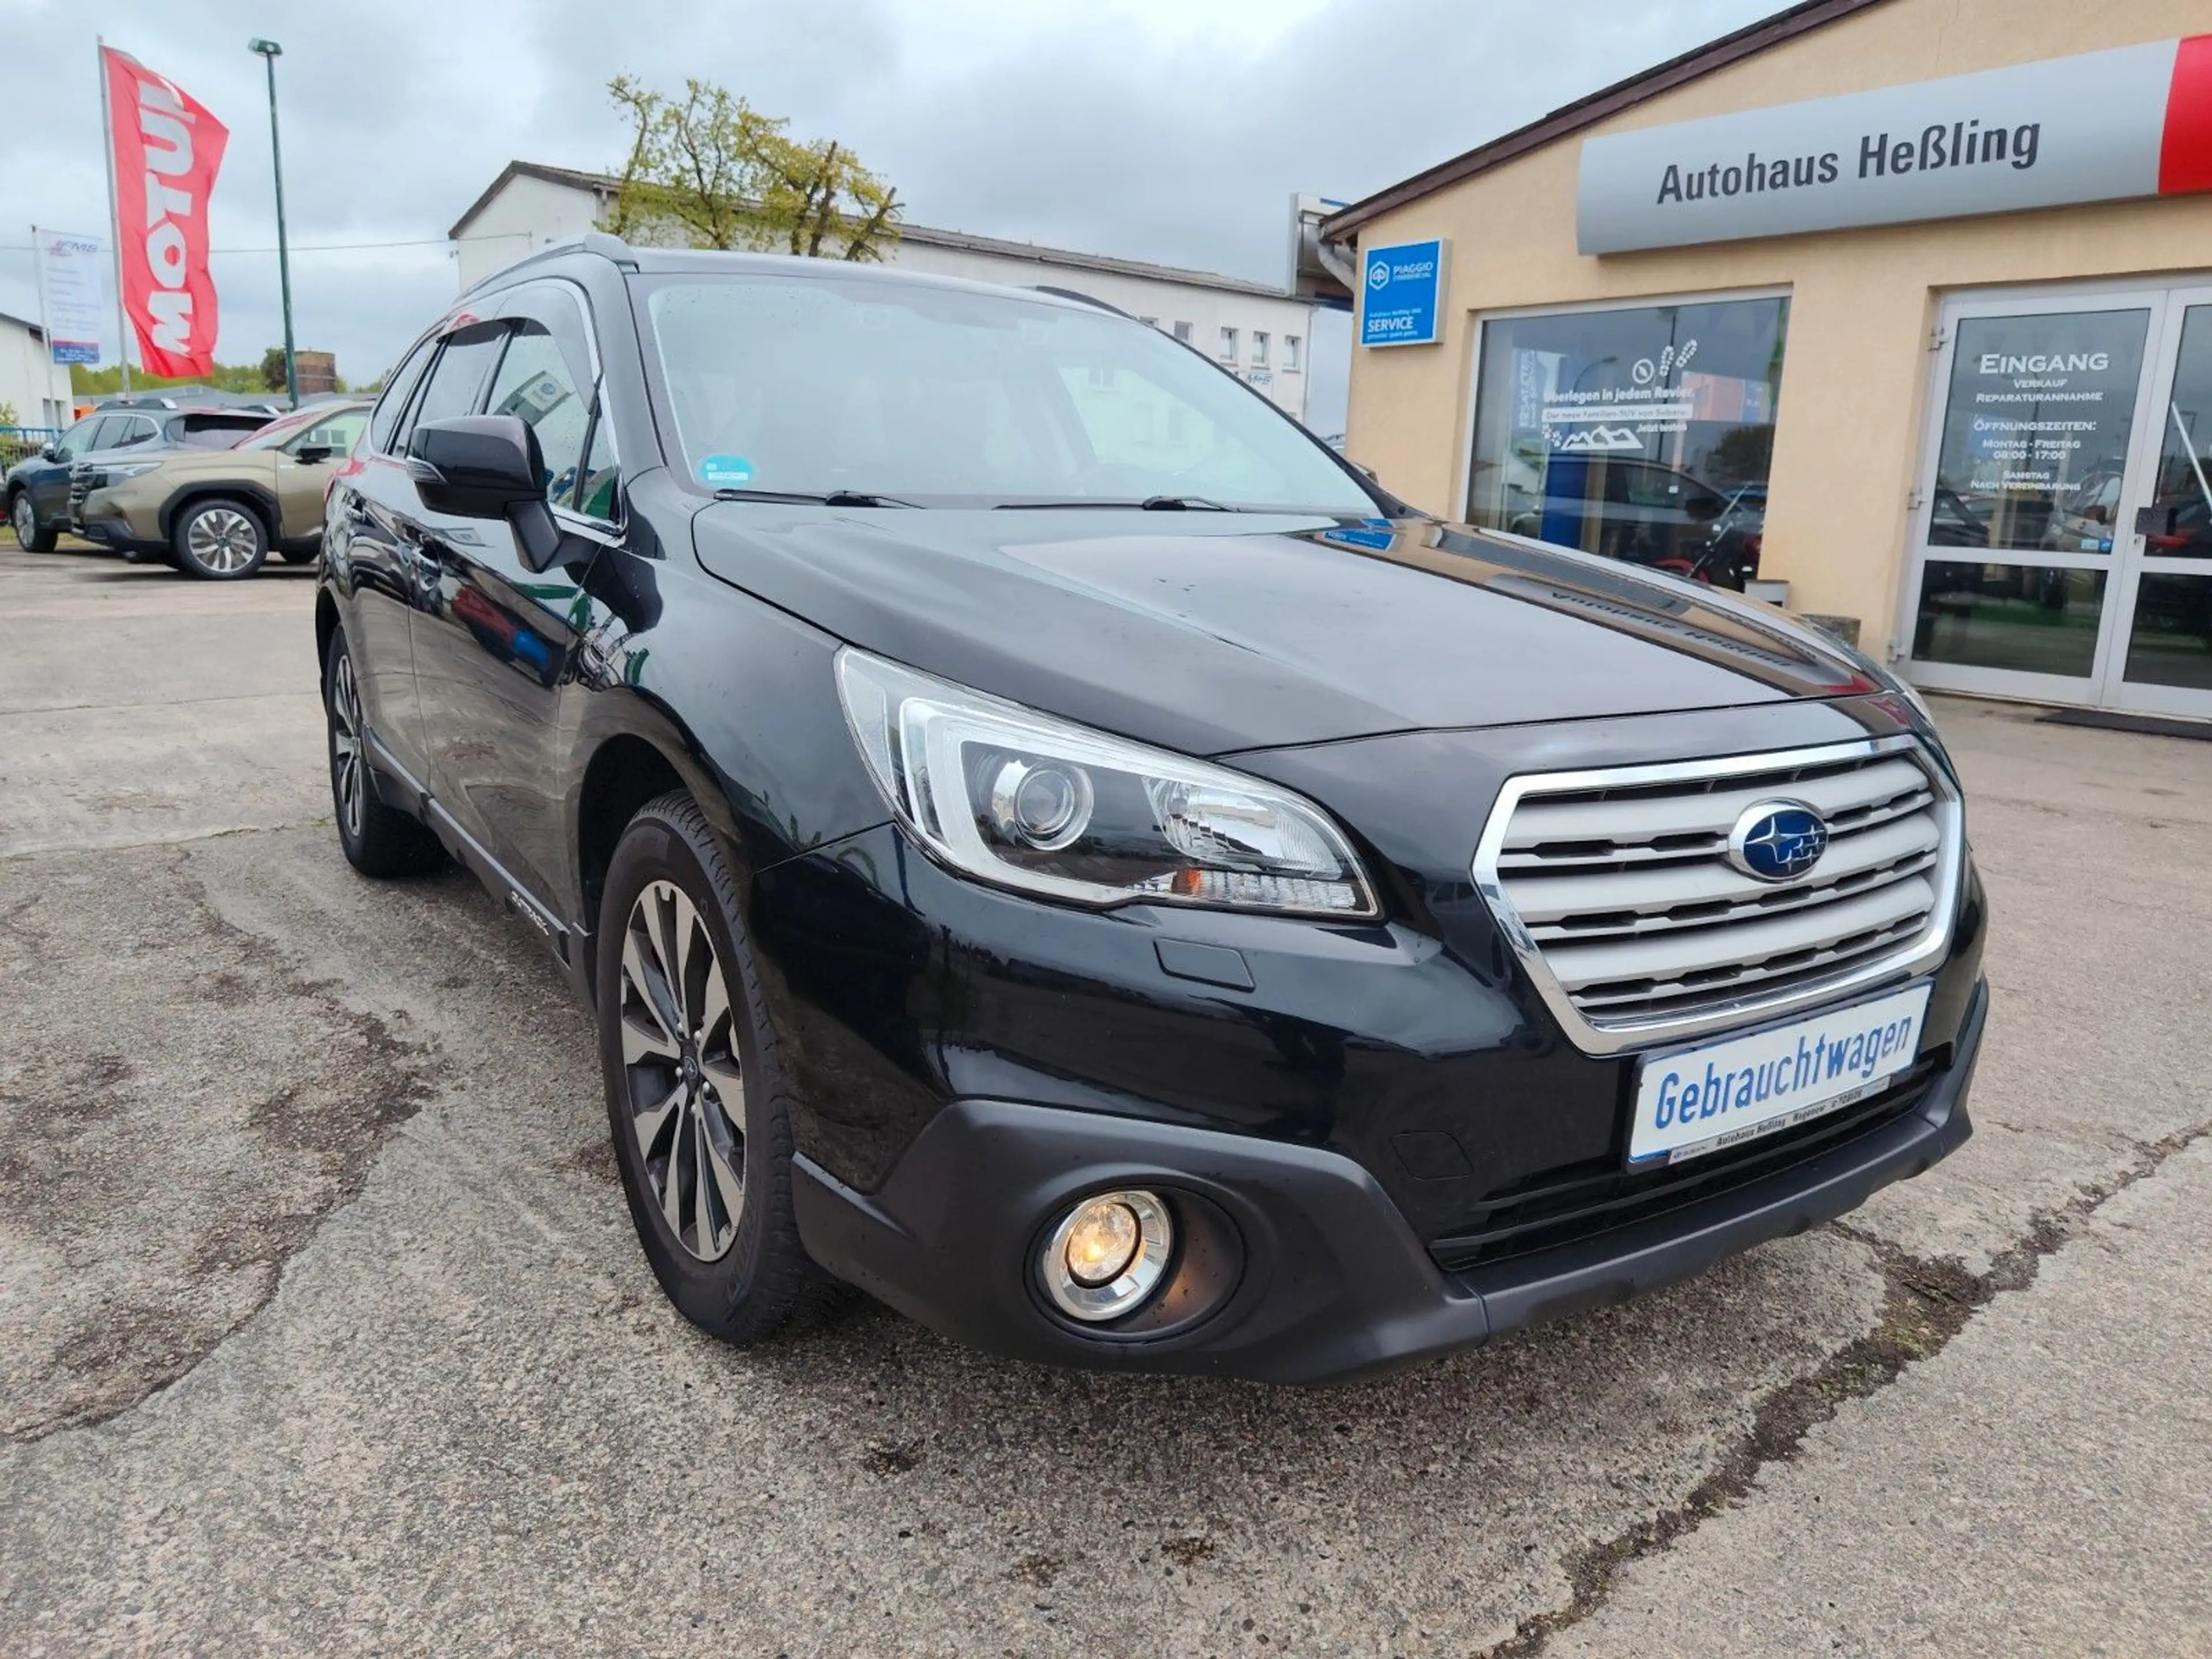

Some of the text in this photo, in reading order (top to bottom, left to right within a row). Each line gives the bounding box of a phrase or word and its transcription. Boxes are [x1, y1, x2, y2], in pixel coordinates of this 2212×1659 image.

[1657, 119, 2041, 204] Autohaus Heßling
[1393, 262, 1433, 275] PIAGGIO
[1368, 316, 1414, 332] SERVICE
[1980, 353, 2109, 374] EINGANG
[2013, 378, 2068, 388] VERKAUF
[1603, 388, 1613, 400] in
[1613, 387, 1652, 403] jedem
[1976, 392, 2104, 403] REPARATURANNAHME
[1983, 440, 2028, 449] MONTAG
[2035, 440, 2081, 449] FREITAG
[2035, 451, 2067, 460] 17:00
[2003, 470, 2050, 479] SAMSTAG
[1970, 480, 1999, 489] NACH
[1655, 1016, 1912, 1129] Gebrauchtwagen
[1715, 1128, 1755, 1147] Autohaus
